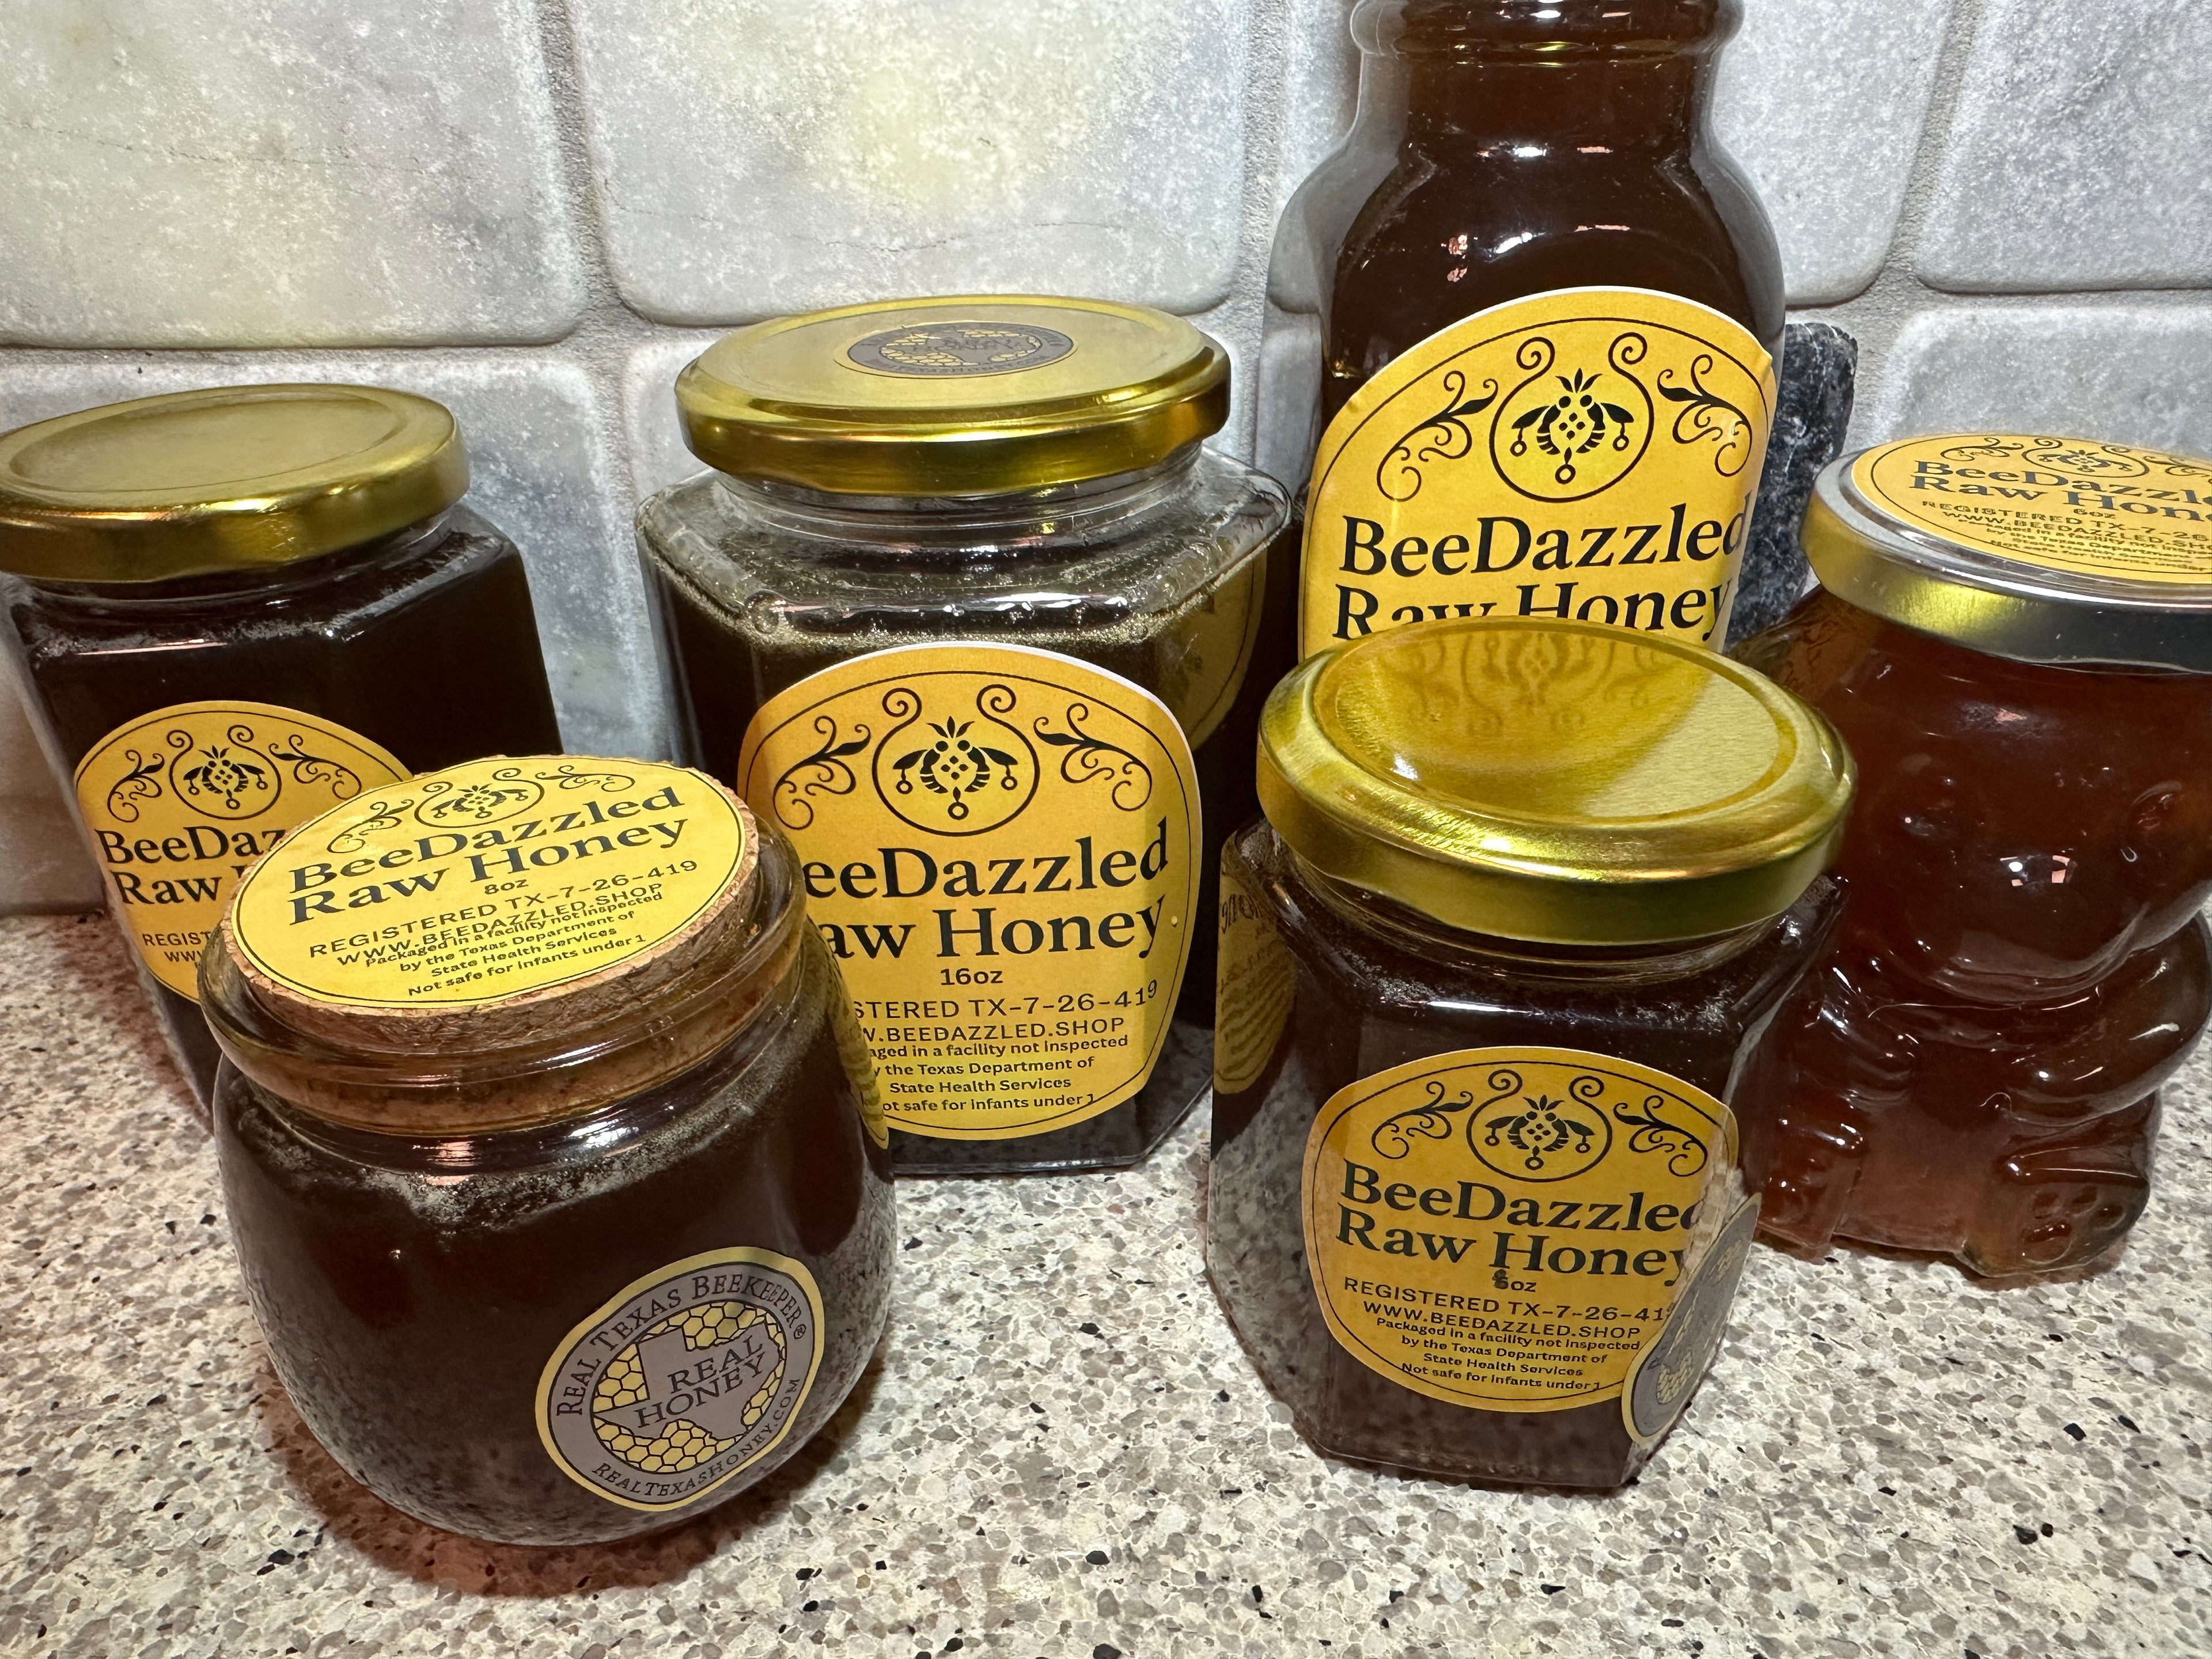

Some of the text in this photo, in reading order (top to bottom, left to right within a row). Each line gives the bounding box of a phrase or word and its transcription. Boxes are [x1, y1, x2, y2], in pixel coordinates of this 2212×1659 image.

[1909, 475, 2212, 522] Raw Hon
[1914, 460, 2212, 506] BeeDazzl
[1339, 490, 1752, 577] BeeDazzled
[1516, 578, 1732, 642] Honey
[94, 826, 286, 863] BeeDaz
[289, 786, 685, 893] BeeDazzled
[802, 816, 1168, 899] eeDazzled
[109, 870, 222, 904] Raw
[287, 819, 688, 926] Raw Honey
[484, 879, 529, 895] 8oz
[310, 860, 698, 958] REGISTERED TX-7-26-419
[337, 883, 662, 967] WWW.BEEDAZZLED.SHOP
[366, 939, 448, 968] Packaged
[453, 937, 469, 946] in
[487, 920, 546, 938] facility
[551, 912, 579, 925] not
[584, 892, 663, 917] inspected
[818, 894, 1165, 959] aw Honey
[400, 910, 634, 972] by the Texas Department of
[408, 982, 442, 996] Not
[446, 972, 483, 986] safe
[487, 964, 513, 976] for
[582, 937, 632, 955] under
[635, 934, 646, 943] 1
[431, 927, 617, 977] State Health Services
[854, 979, 1157, 1019] STERED TX-7-26-419
[940, 968, 1003, 986] 16oz
[885, 1064, 914, 1075] the
[917, 1064, 964, 1075] Texas
[969, 1059, 1073, 1076] Department
[1077, 1056, 1094, 1068] of
[912, 1046, 928, 1057] in
[933, 1047, 943, 1056] a
[946, 1043, 1006, 1057] facility
[1010, 1042, 1040, 1054] not
[1044, 1035, 1128, 1053] inspected
[882, 1093, 1094, 1111] ot safe for infants under 1
[890, 1078, 1071, 1093] State Health Services
[1336, 1202, 1685, 1287] Raw Honey
[1344, 1277, 1665, 1321] REGISTERED TX-7-26-41
[1363, 1301, 1641, 1339] WWW.BEEDAZZLED.SHOP
[556, 1357, 601, 1416] REAL
[590, 1288, 683, 1351] TEXAS
[1377, 1317, 1445, 1336] Packaged
[1450, 1327, 1463, 1338] in
[1480, 1331, 1532, 1347] facility
[1536, 1338, 1562, 1347] not
[1566, 1339, 1640, 1351] inspected
[1402, 1335, 1608, 1363] by the Texas Department of
[668, 1335, 763, 1394] REAL
[1402, 1362, 1429, 1374] Not
[1432, 1369, 1461, 1380] safe
[1466, 1372, 1487, 1382] for
[1546, 1380, 1593, 1389] under
[1593, 1382, 1600, 1390] 1
[1423, 1353, 1584, 1376] State Health Services
[634, 1351, 766, 1429] HONEY
[592, 1378, 801, 1497] REALTEXASHONEY.COM
